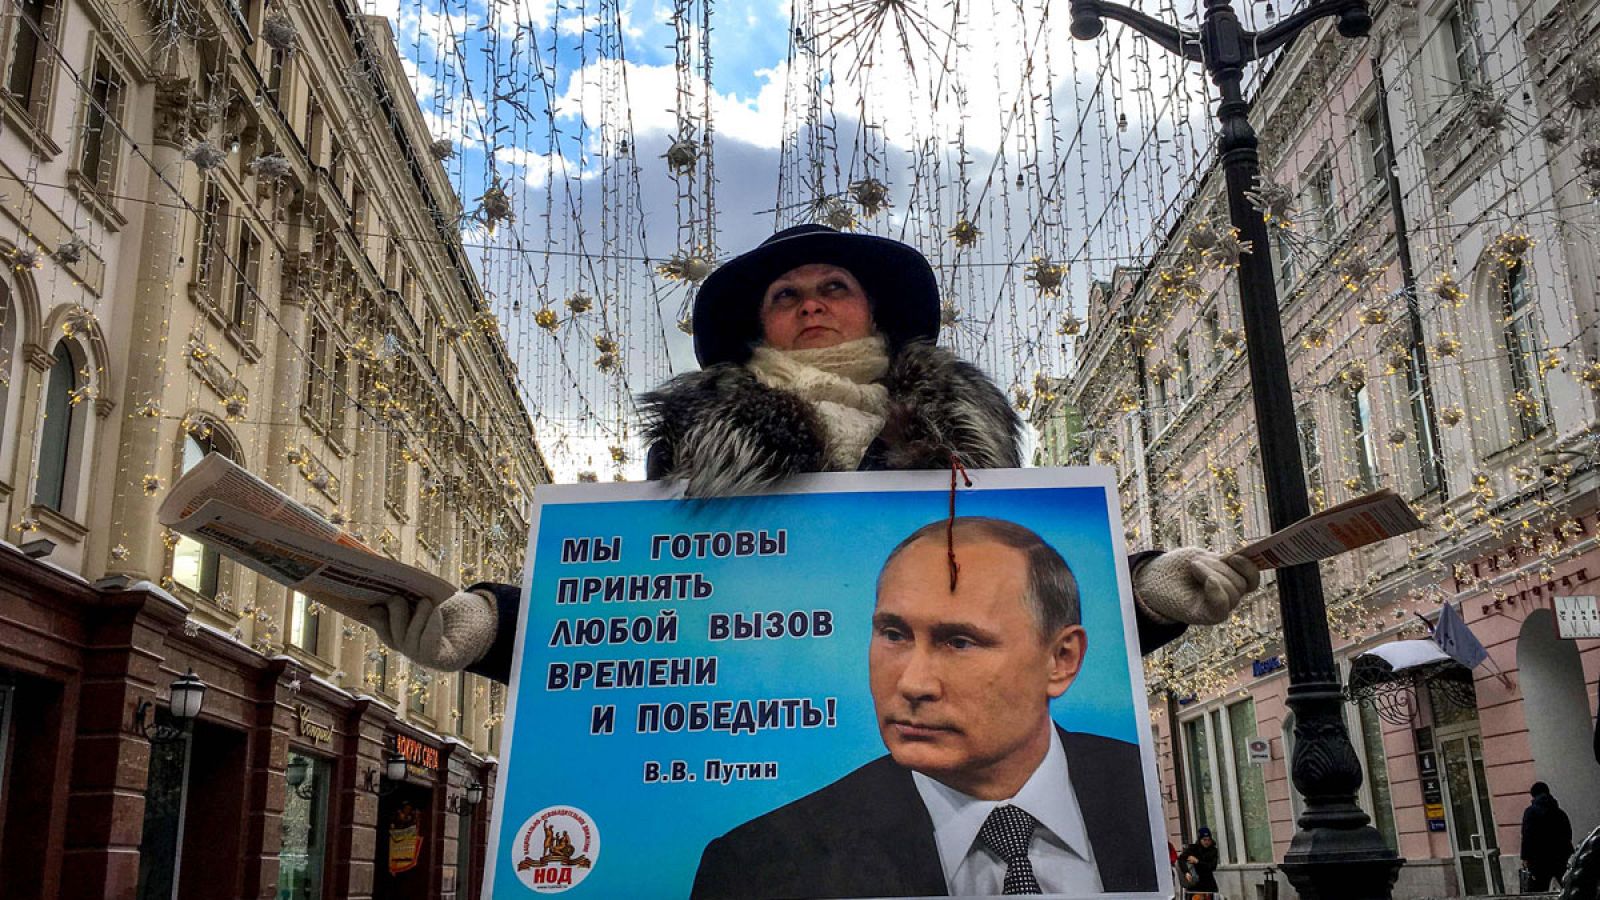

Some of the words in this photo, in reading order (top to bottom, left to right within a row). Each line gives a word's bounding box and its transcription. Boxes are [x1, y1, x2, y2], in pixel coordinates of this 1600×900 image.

[561, 536, 622, 564] МЫ
[651, 529, 787, 560] ГОТОВЫ
[557, 573, 713, 604] ПРИНЯТЬ
[549, 609, 679, 647] ЛЮБОЙ
[708, 610, 833, 641] ВЫЗОВ
[547, 657, 718, 691] ВРЕМЕНИ
[590, 704, 616, 735] И
[636, 697, 837, 735] ПОБЕДИТЬ!
[643, 759, 696, 783] В.В.
[704, 759, 778, 784] Путин
[533, 867, 573, 884] НОД
